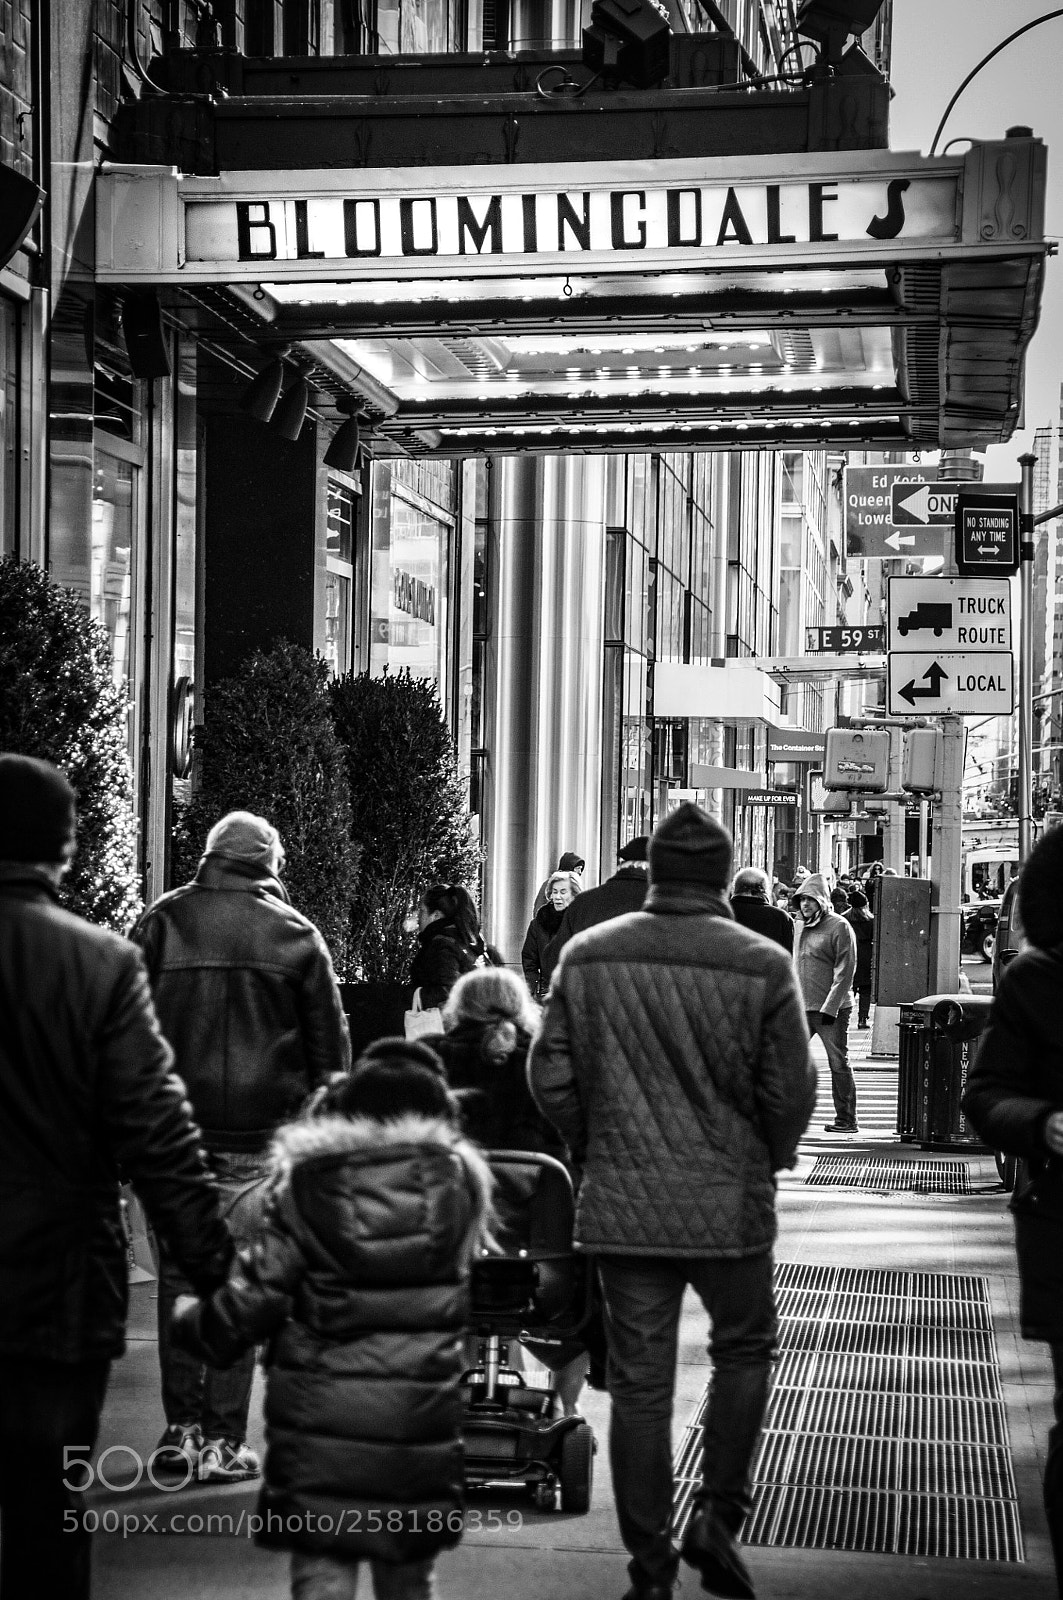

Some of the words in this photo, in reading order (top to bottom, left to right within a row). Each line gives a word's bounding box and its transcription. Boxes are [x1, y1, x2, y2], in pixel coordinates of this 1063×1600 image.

[872, 475, 887, 488] Ed
[966, 517, 976, 528] NO
[979, 517, 1009, 528] STANDING
[970, 531, 987, 541] ANY
[989, 531, 1006, 542] TIME
[958, 597, 1006, 615] TRUCK
[822, 630, 832, 647] E
[841, 629, 863, 647] 59
[867, 629, 880, 639] ST
[958, 627, 1006, 644] ROUTE
[957, 675, 1007, 692] LOCAL
[783, 744, 814, 752] Container
[959, 1042, 969, 1133] NEWSPARS
